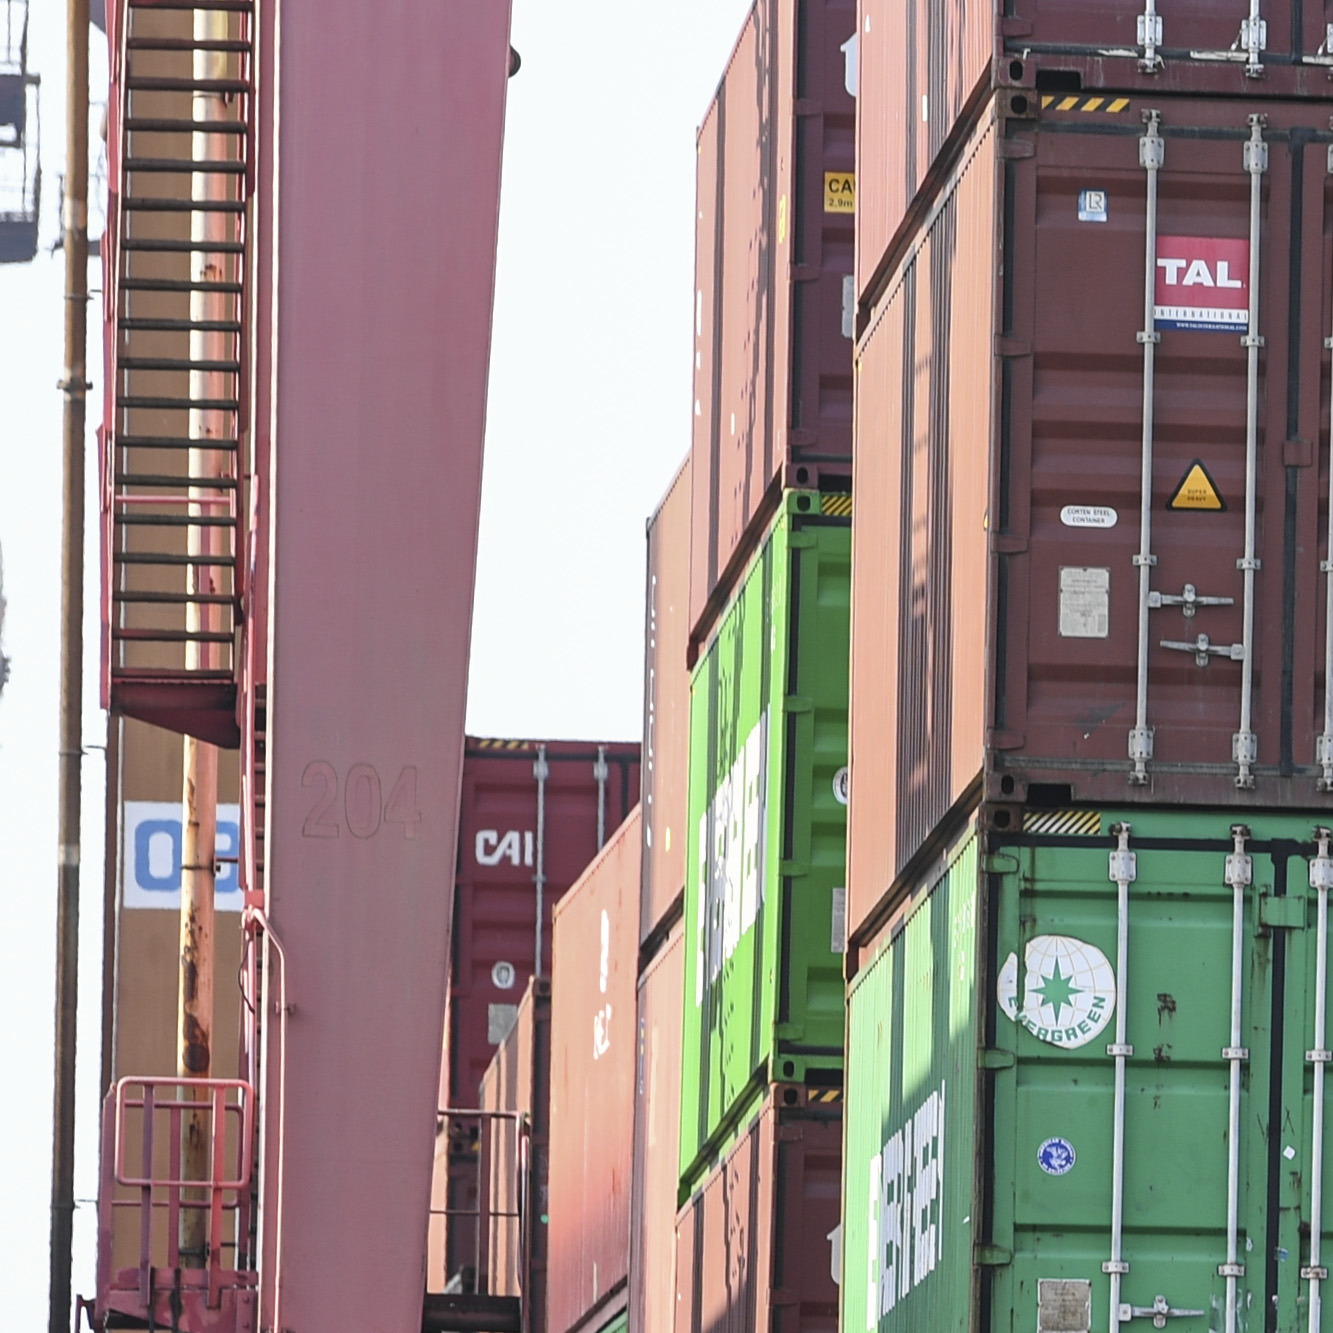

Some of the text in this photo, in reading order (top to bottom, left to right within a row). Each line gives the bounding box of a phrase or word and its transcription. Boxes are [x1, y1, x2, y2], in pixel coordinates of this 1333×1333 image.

[1157, 259, 1241, 288] TAL
[301, 760, 422, 841] 204
[1008, 996, 1106, 1042] EVERGREEN
